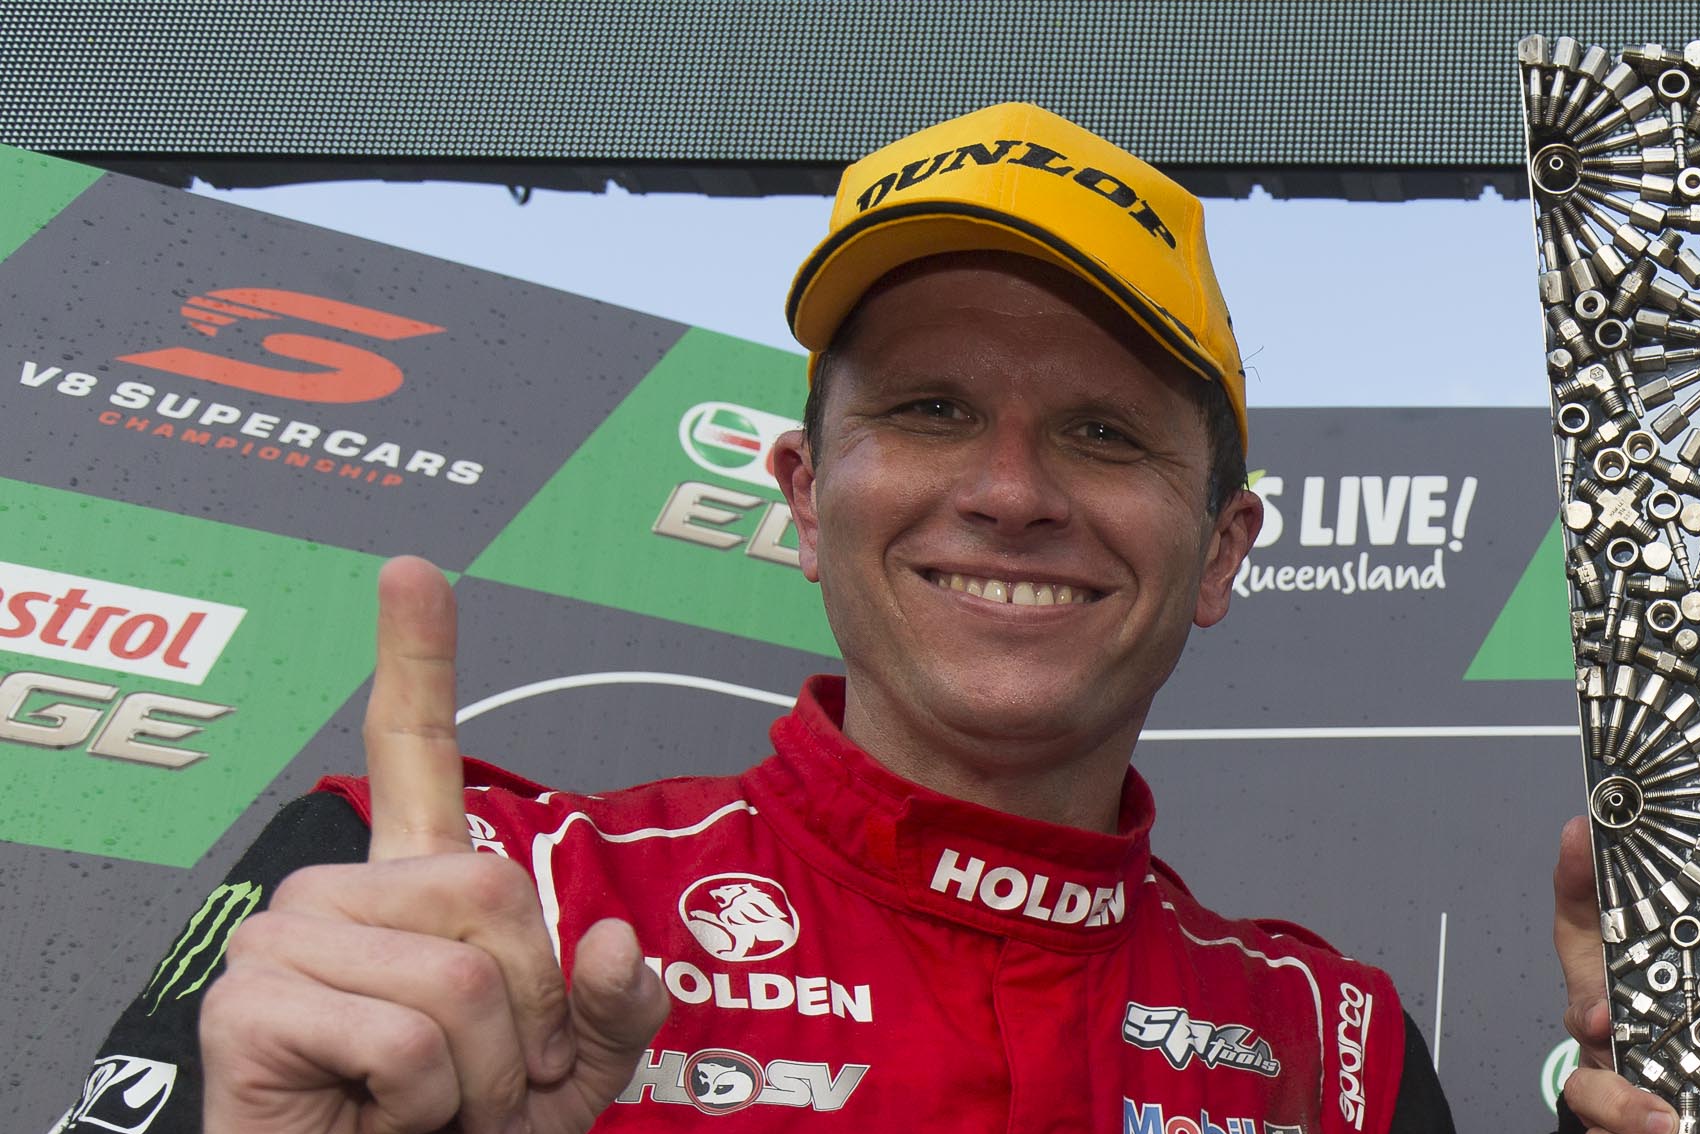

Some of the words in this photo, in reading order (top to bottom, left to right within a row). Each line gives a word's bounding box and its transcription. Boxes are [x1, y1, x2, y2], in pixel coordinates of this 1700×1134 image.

[856, 140, 1177, 250] DUNLOP
[19, 361, 98, 397] V8
[109, 380, 485, 485] SUPERCARS
[98, 411, 403, 487] CHAMPIONSHIP
[1300, 475, 1478, 553] LIVE!
[0, 588, 208, 669] strol
[0, 670, 238, 770] GE
[930, 848, 1125, 927] HOLDEN
[1337, 983, 1367, 1123] sparco
